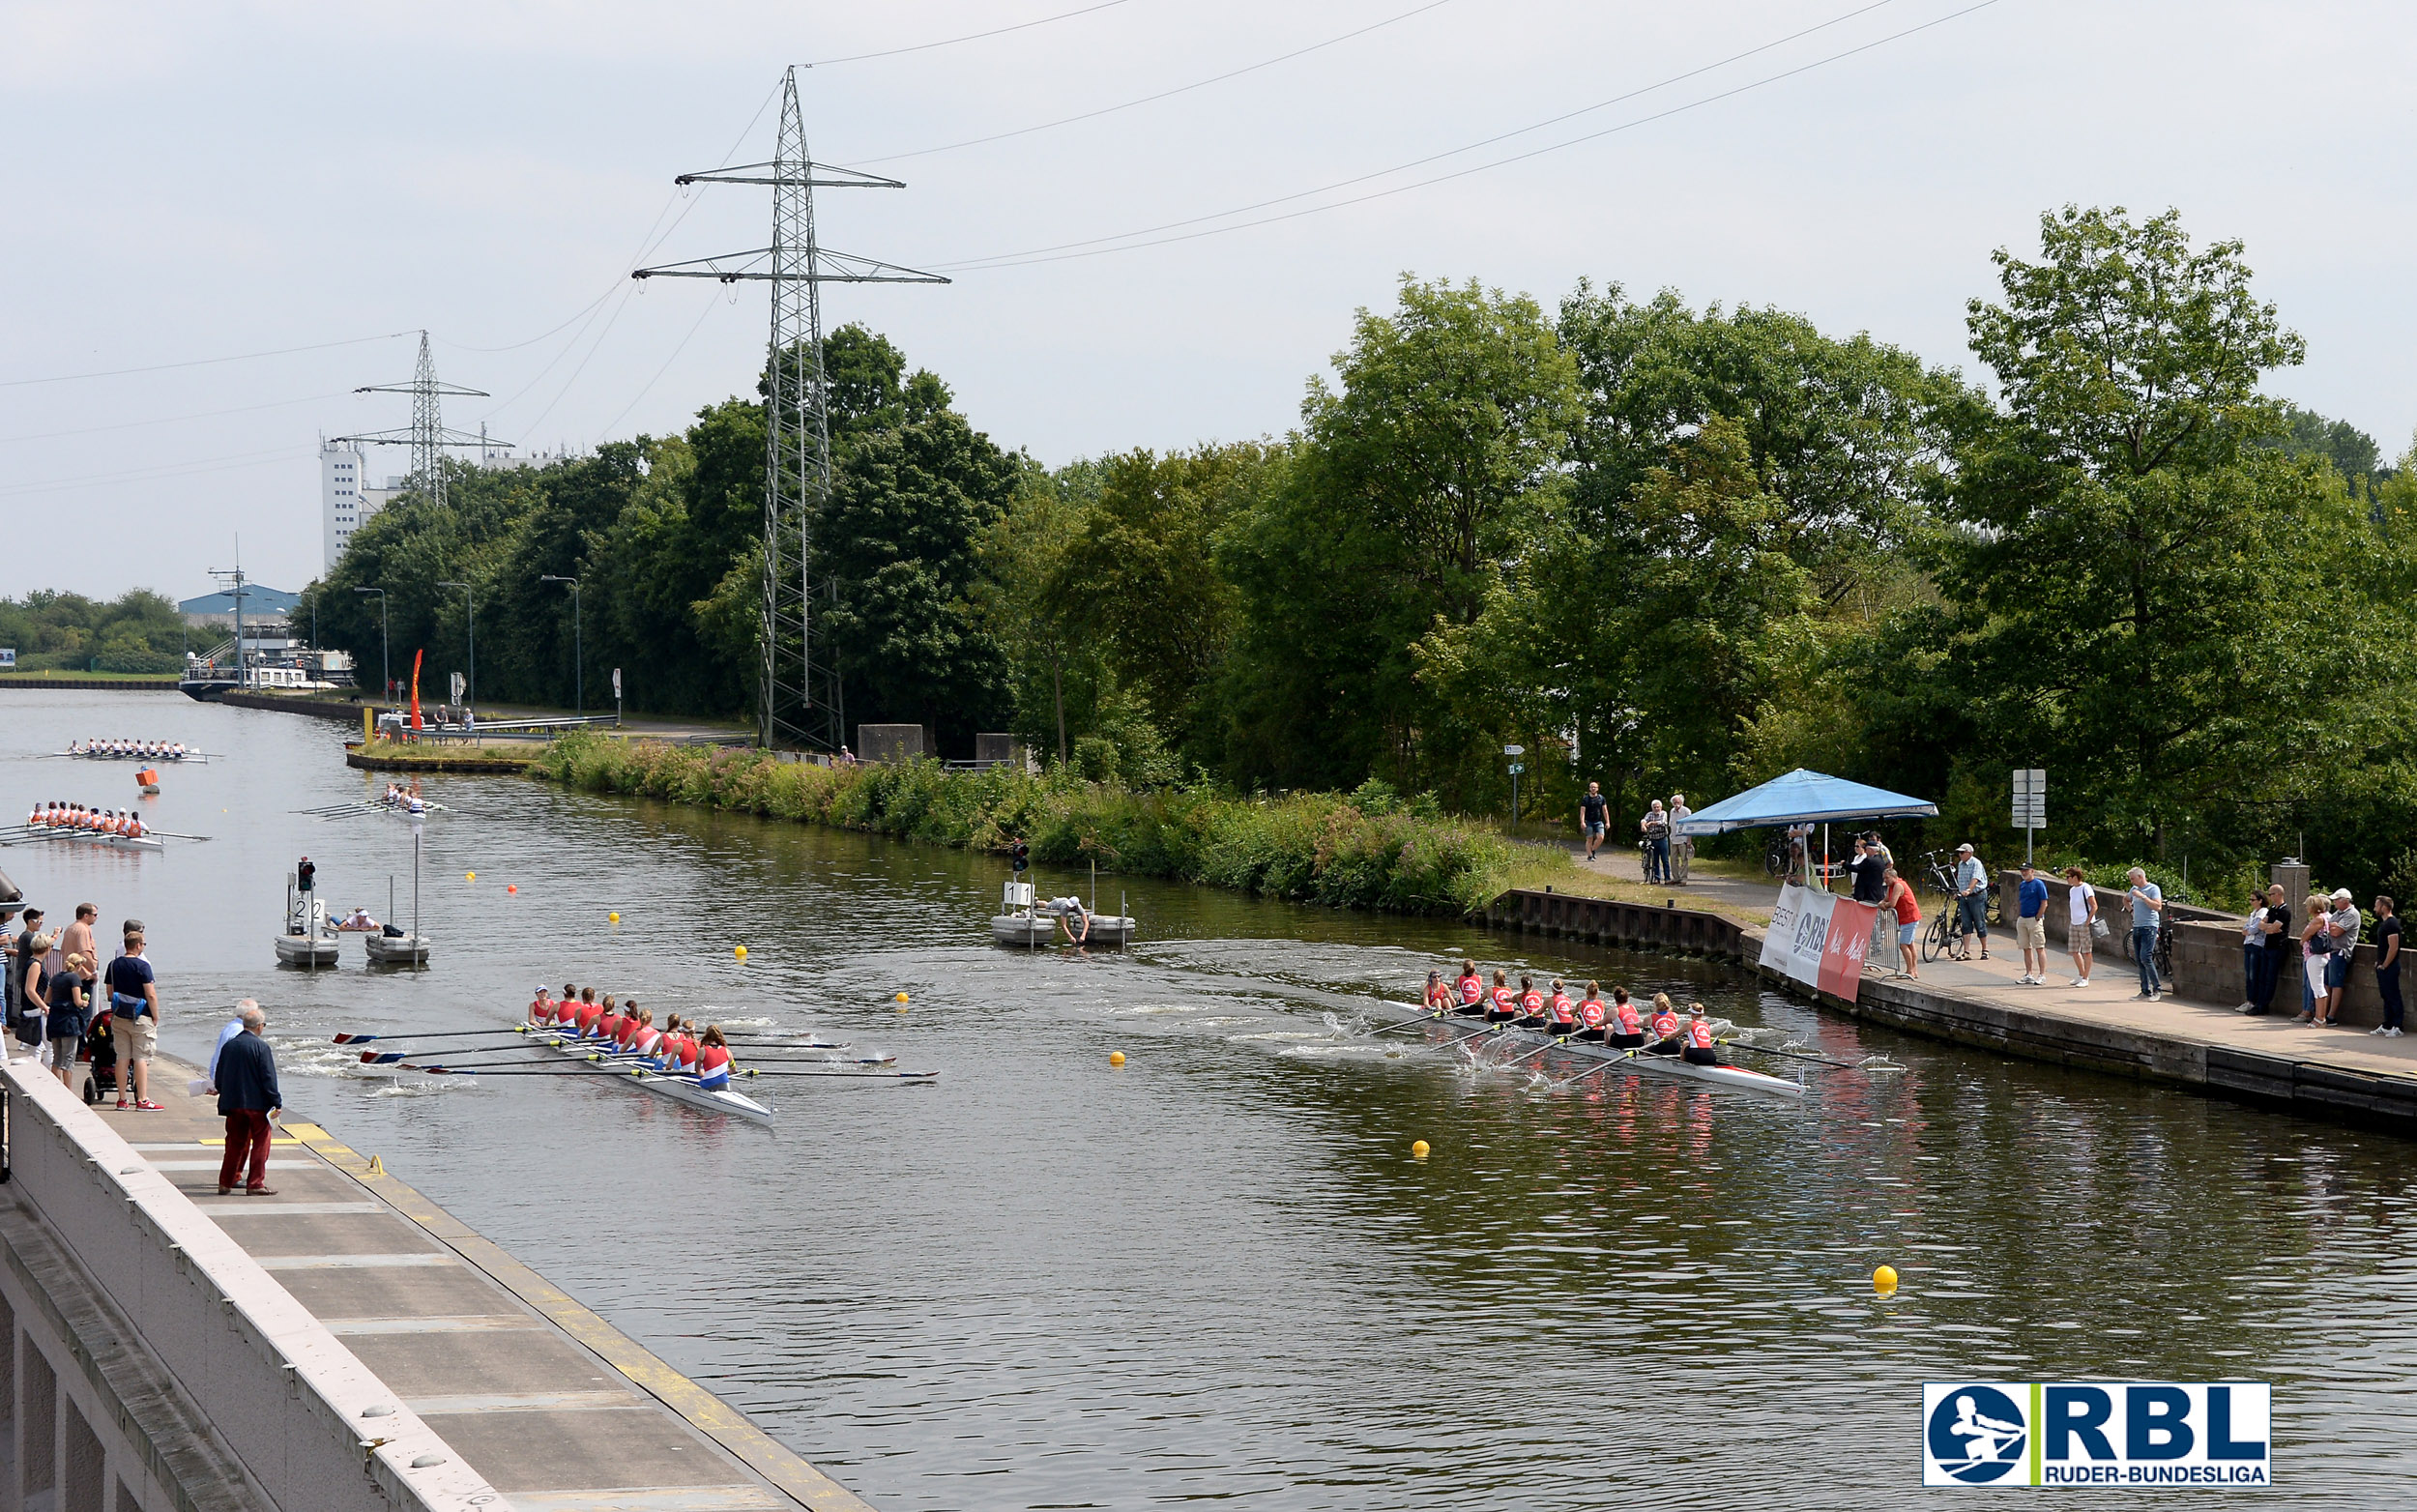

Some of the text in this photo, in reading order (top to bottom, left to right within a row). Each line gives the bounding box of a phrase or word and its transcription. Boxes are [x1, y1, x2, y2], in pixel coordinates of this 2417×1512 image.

[1008, 886, 1014, 901] 1
[1025, 887, 1030, 902] 1
[295, 900, 306, 917] 2
[312, 902, 321, 918] 2
